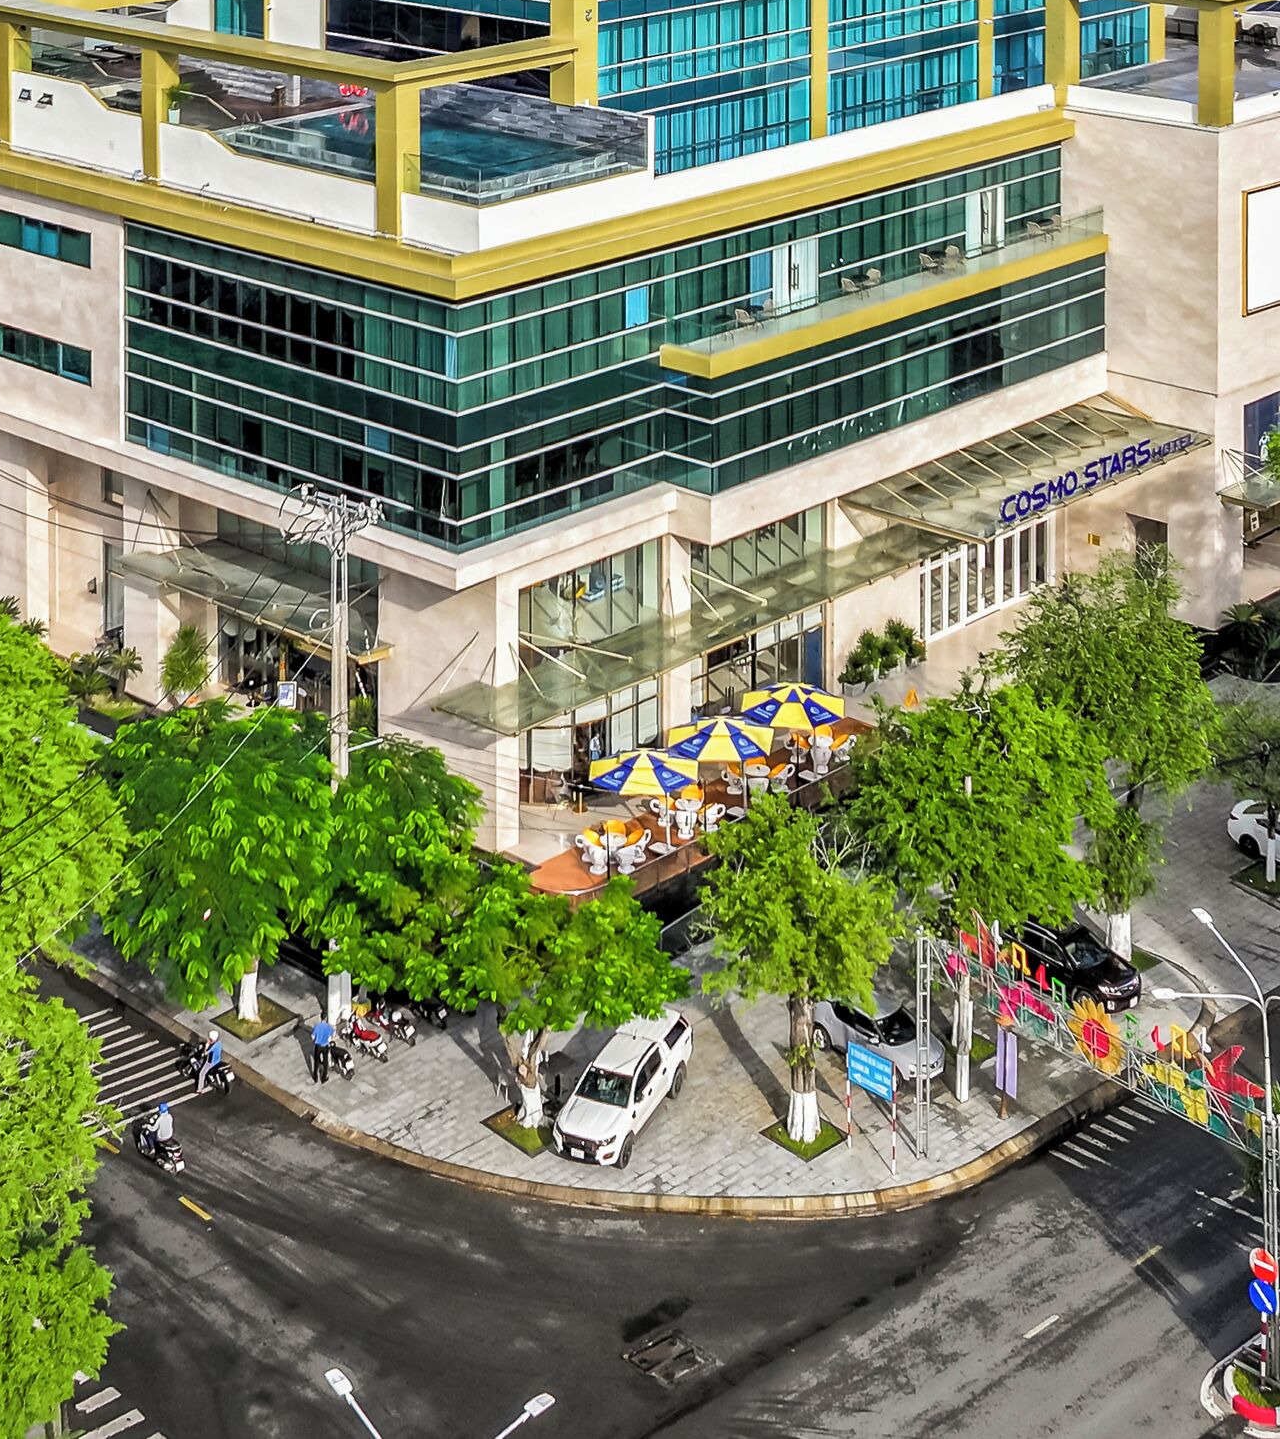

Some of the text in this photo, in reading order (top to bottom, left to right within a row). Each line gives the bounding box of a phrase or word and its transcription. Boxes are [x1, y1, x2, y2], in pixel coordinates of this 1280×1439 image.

[999, 433, 1196, 524] COSMO STARS HOTEL
